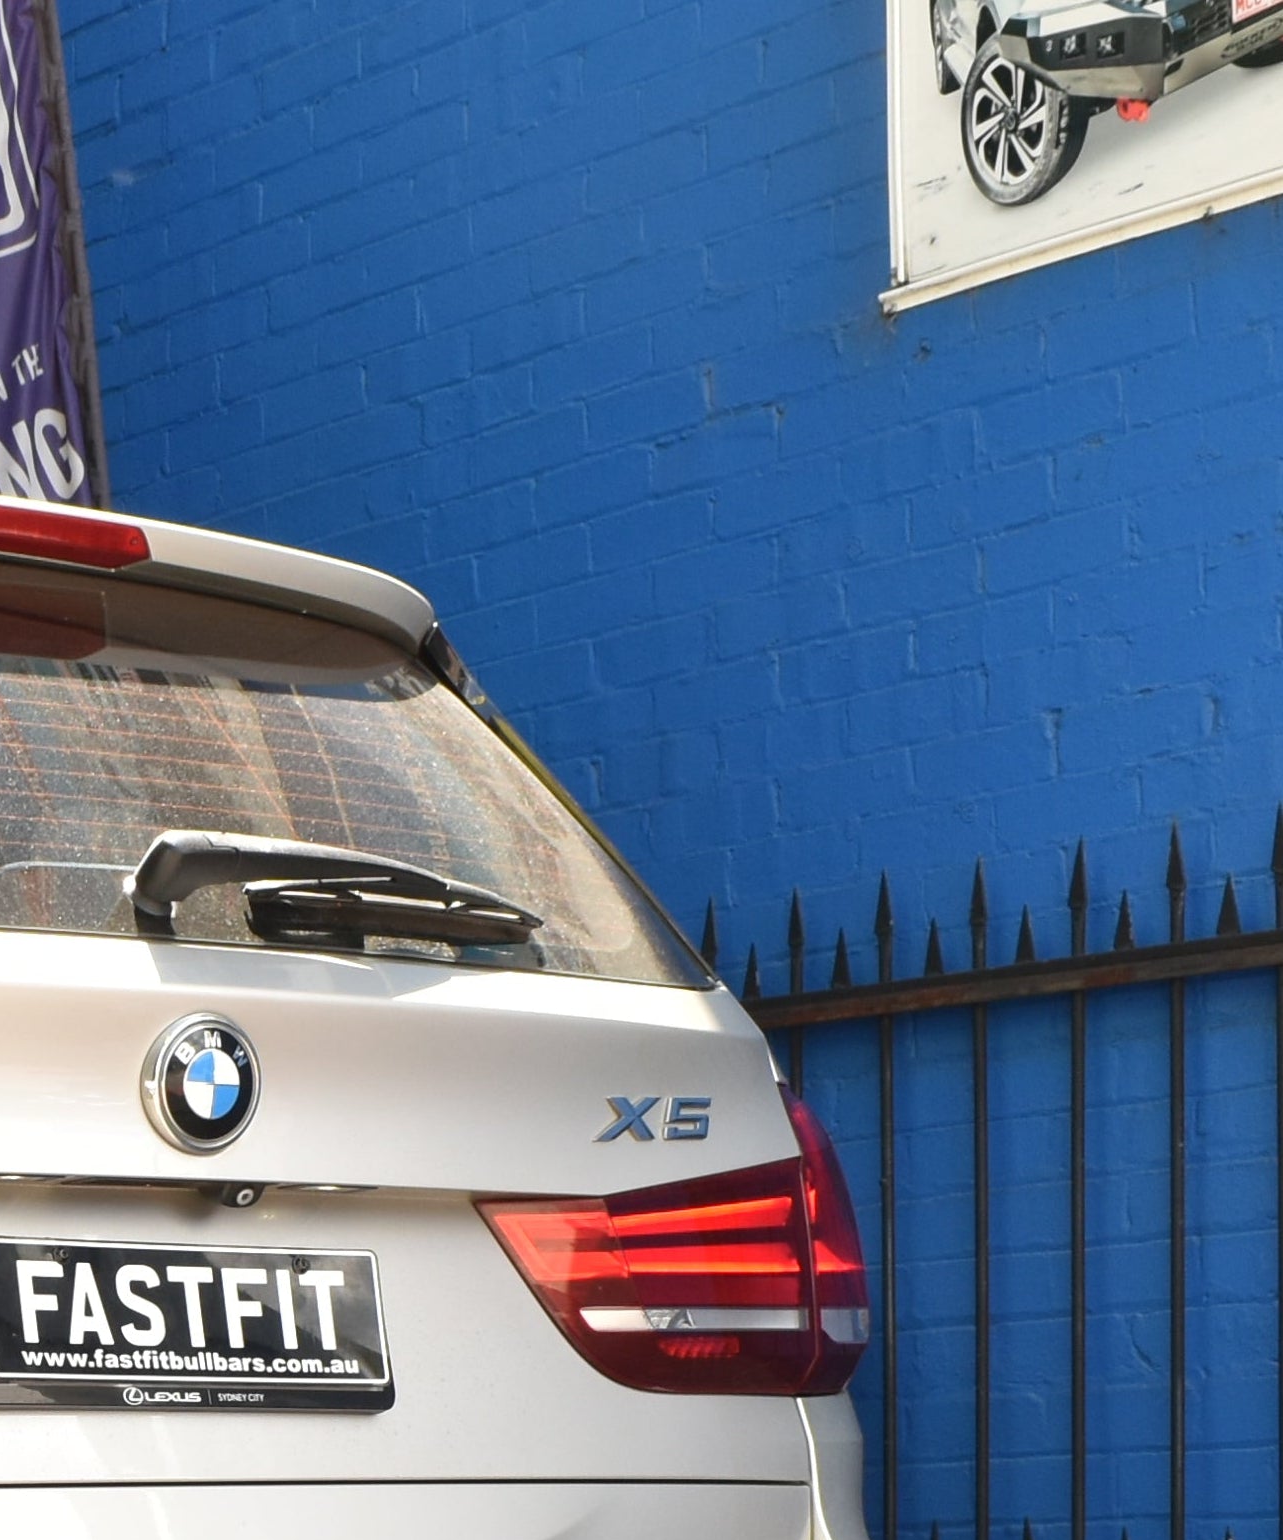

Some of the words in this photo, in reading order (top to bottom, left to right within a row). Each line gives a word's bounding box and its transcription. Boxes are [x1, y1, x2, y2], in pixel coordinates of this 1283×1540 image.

[174, 1030, 248, 1068] BMW
[591, 1096, 711, 1143] X5
[15, 1259, 345, 1351] FASTFIT
[21, 1348, 360, 1375] www.fastfitbullbars.com.au
[145, 1391, 202, 1403] LEXUS
[217, 1392, 246, 1402] SYDNEY
[248, 1393, 265, 1402] CITY
